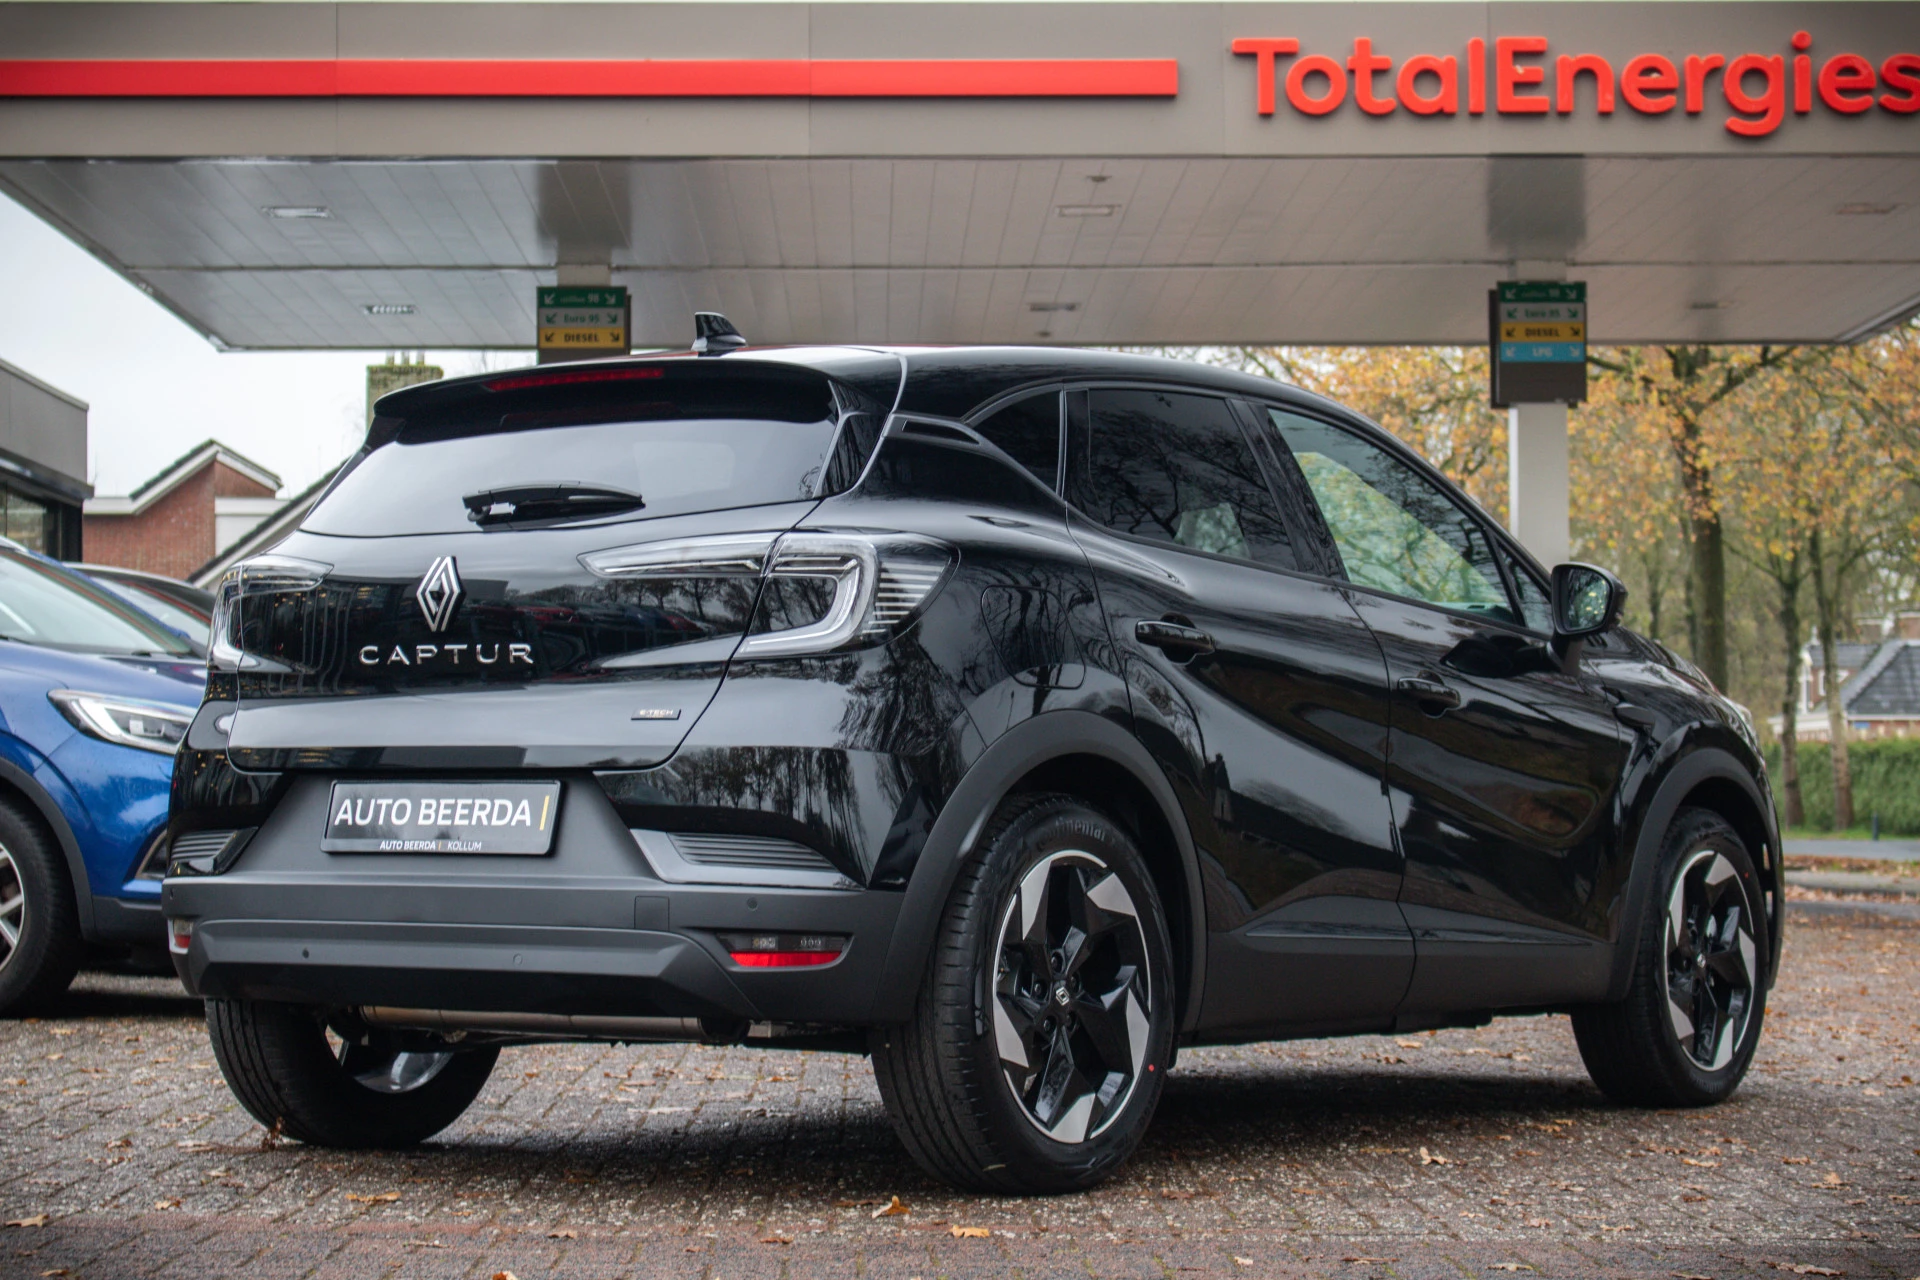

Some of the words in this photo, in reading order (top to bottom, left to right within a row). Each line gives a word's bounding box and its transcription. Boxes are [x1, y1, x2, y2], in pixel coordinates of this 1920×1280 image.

[1231, 30, 1920, 136] TotalEnergies
[563, 332, 599, 342] DIESEL
[358, 643, 534, 666] CAPTUR
[334, 799, 411, 826] AUTO
[417, 799, 532, 826] BEERDA
[380, 840, 403, 850] AUTO
[403, 841, 436, 851] BEERDA
[447, 841, 482, 851] KOLLUM
